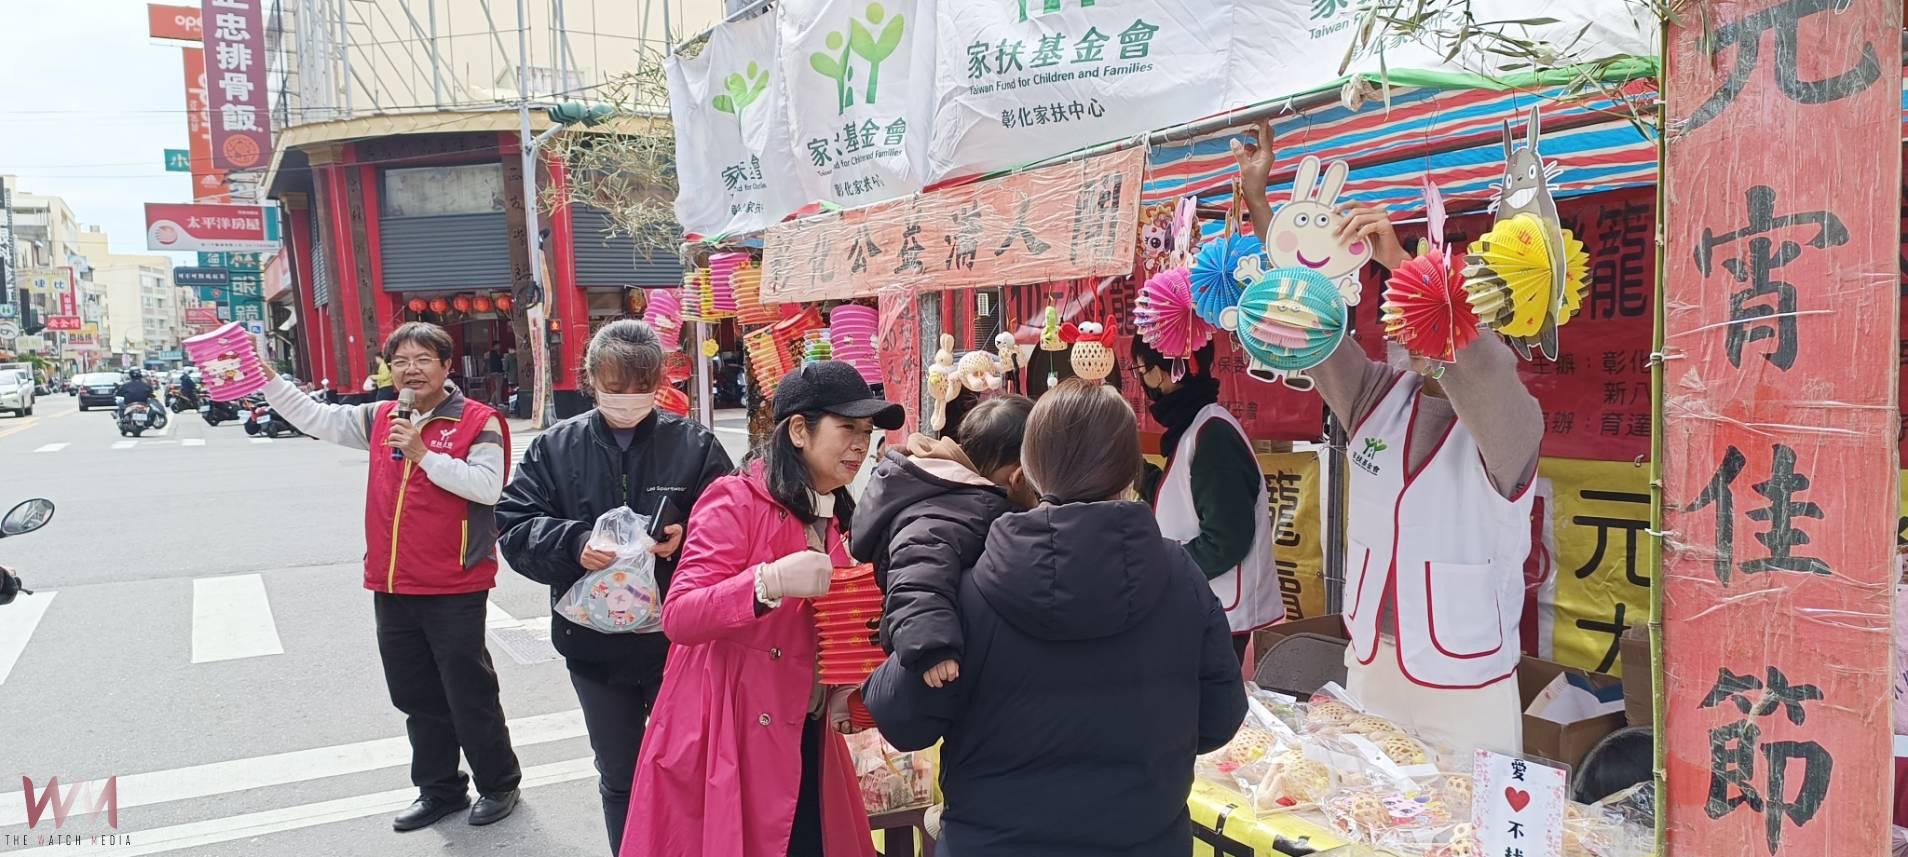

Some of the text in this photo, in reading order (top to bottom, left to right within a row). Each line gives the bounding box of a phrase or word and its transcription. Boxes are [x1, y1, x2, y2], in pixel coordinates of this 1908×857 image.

[1308, 19, 1350, 40] Taiwan
[967, 18, 1160, 79] 家扶基金會
[970, 61, 1154, 96] Taiwan Fund for Children and Families
[1001, 97, 1106, 129] 彰化家扶中心
[187, 215, 261, 231] 太平洋房屋
[1678, 0, 1882, 856] 元宵佳節
